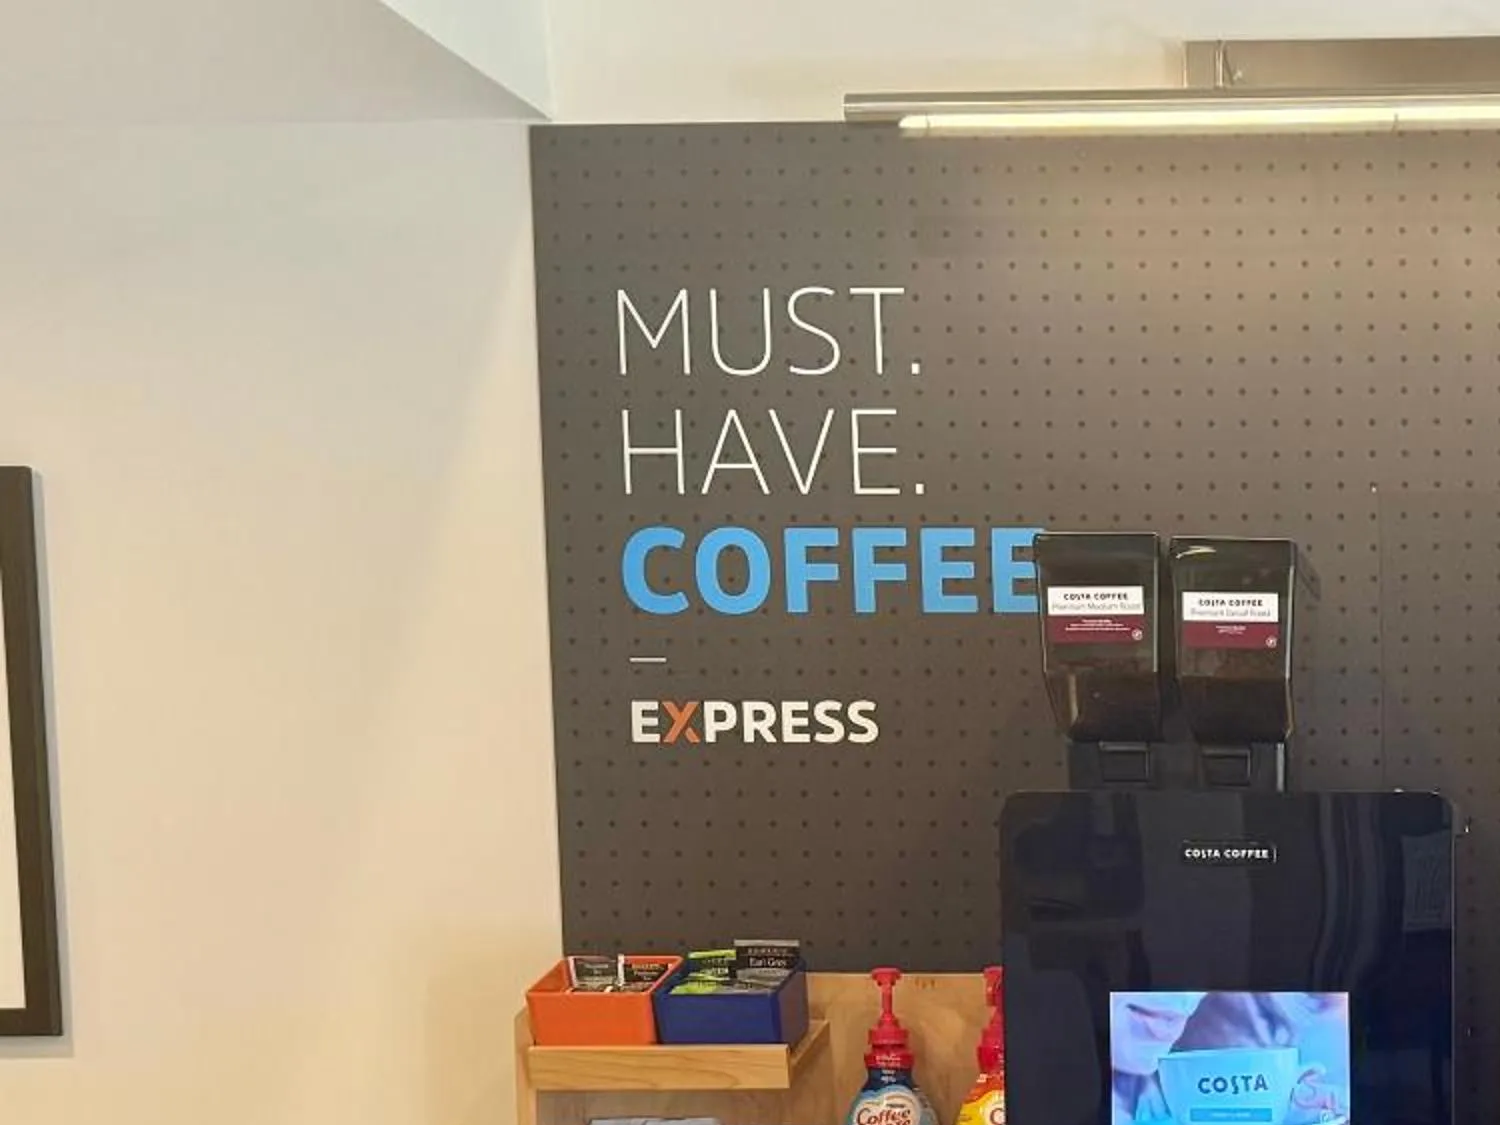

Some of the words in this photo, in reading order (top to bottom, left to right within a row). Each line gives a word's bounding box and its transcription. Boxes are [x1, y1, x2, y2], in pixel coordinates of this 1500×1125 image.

[616, 287, 921, 376] MUST.
[621, 408, 925, 495] HAVE.
[621, 526, 1047, 615] COFFEE
[631, 700, 879, 743] EXPRESS
[1184, 848, 1221, 859] COSTA
[1223, 848, 1269, 859] COFFEE
[1197, 1073, 1269, 1095] COSTA
